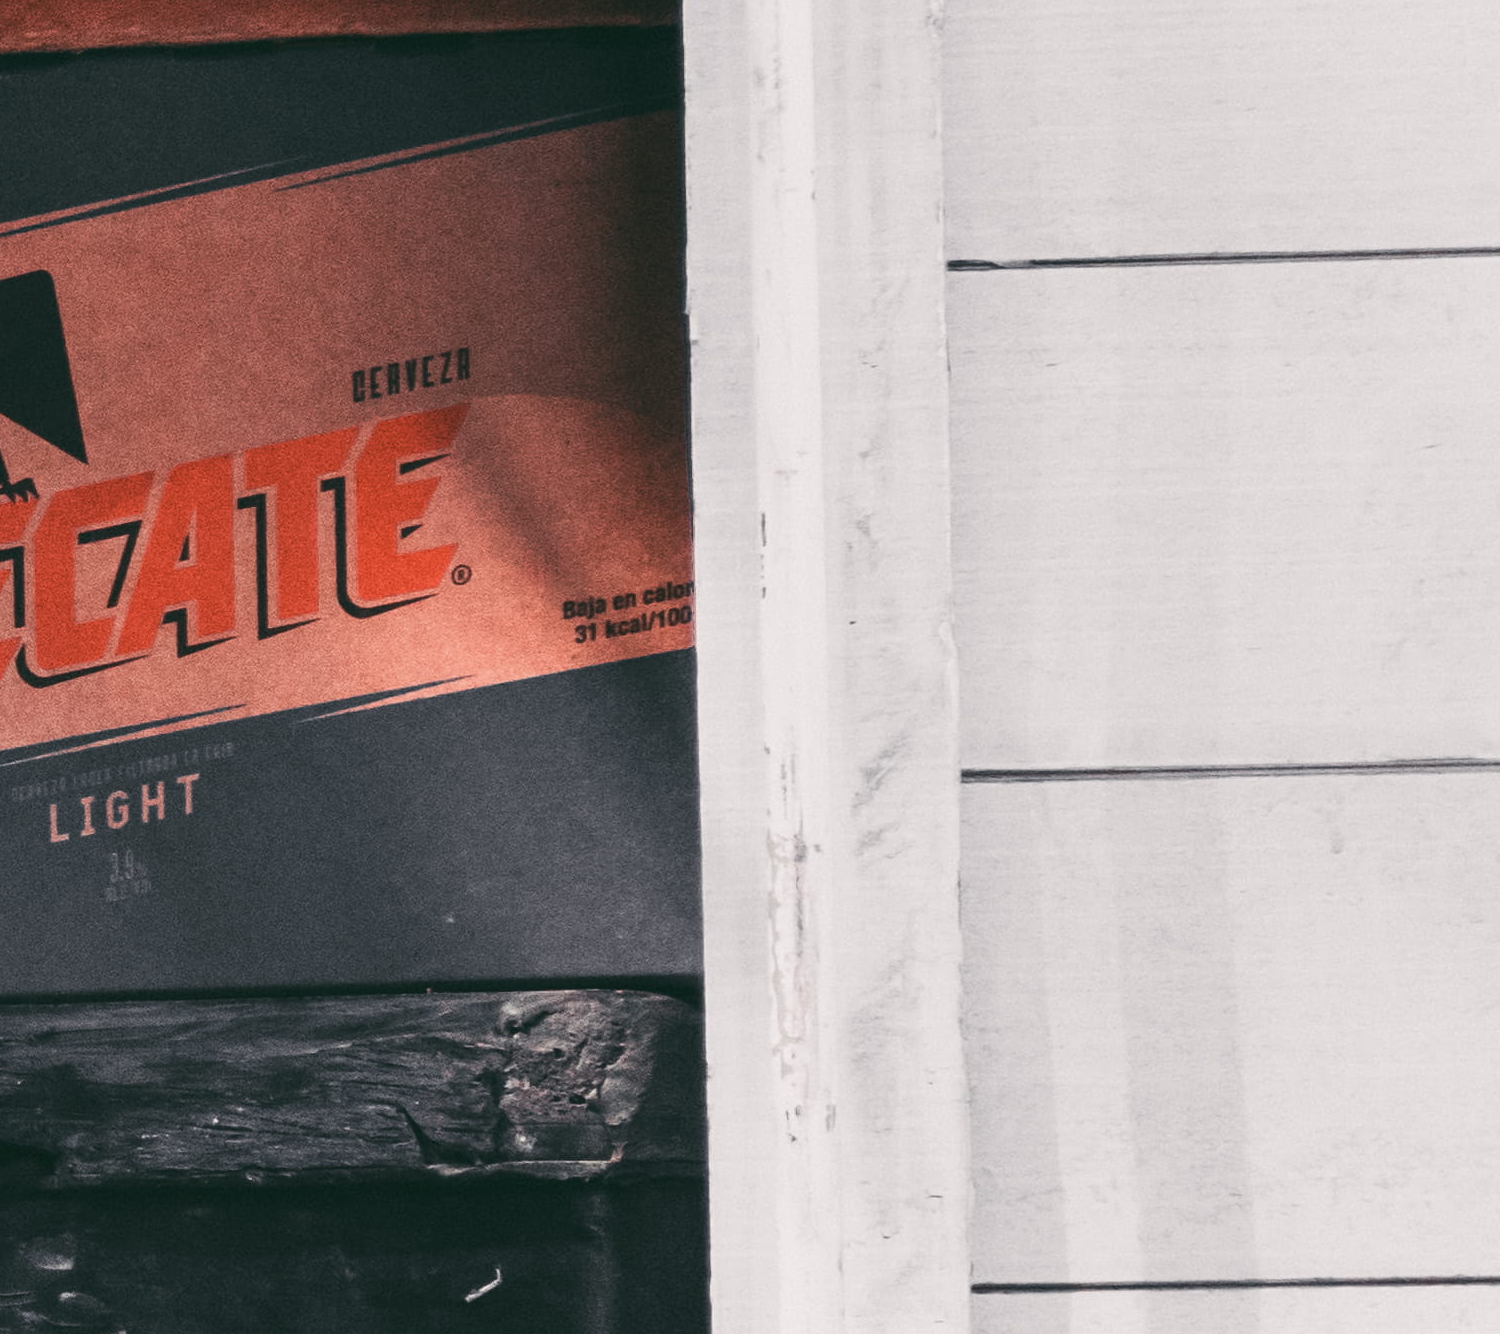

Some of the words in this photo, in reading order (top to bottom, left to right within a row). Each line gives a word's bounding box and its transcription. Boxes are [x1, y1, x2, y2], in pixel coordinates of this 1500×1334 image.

[351, 347, 472, 404] CERVEZA
[562, 597, 606, 619] Baja
[612, 592, 637, 611] en
[574, 622, 597, 644] 31
[605, 605, 693, 639] kcal/100
[50, 772, 201, 844] LIGHT
